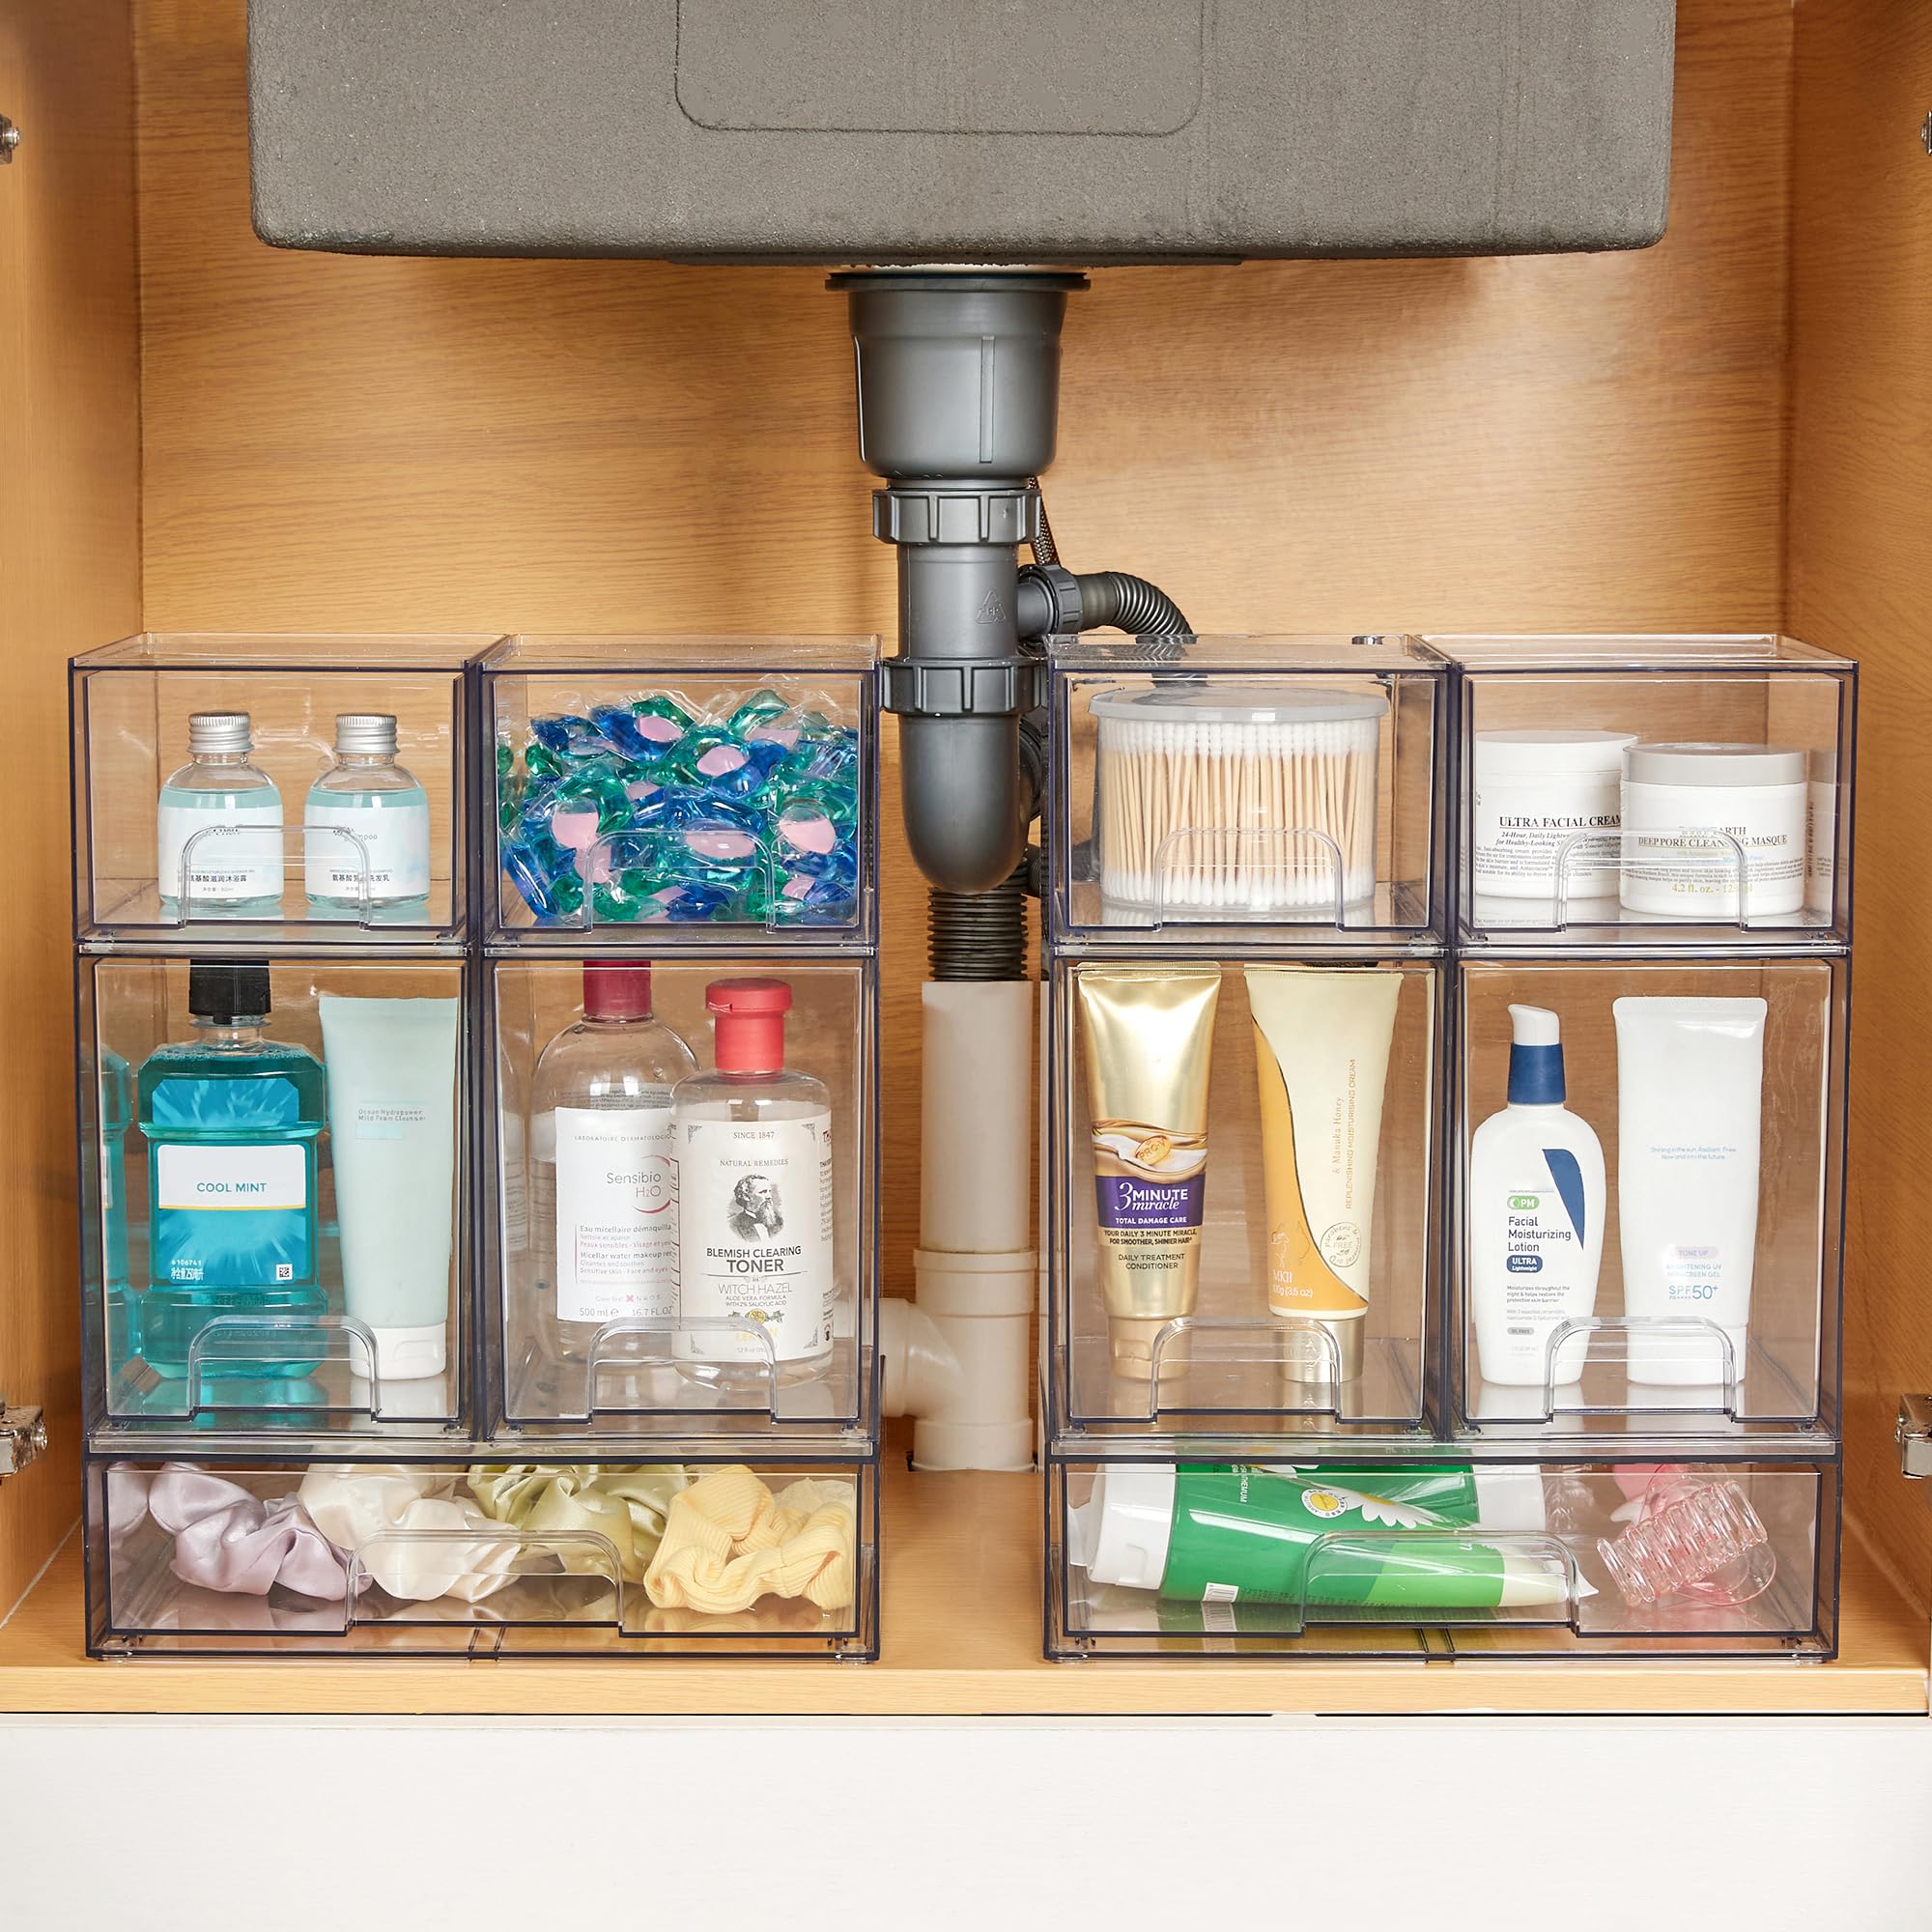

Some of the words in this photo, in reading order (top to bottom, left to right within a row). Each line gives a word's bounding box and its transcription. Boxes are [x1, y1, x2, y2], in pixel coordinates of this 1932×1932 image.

[1499, 816, 1539, 827] ULTRA
[1543, 817, 1586, 827] FACIAL
[1638, 837, 1659, 846] DEEP
[1661, 838, 1687, 847] PORE
[1751, 835, 1787, 846] MASQUE
[1672, 884, 1686, 893] 4.2
[1332, 1096, 1345, 1124] Honey
[1332, 1128, 1342, 1163] Manuka
[754, 1158, 789, 1167] REMEDIES
[607, 1172, 662, 1184] Sensibio
[196, 1182, 232, 1193] COOL
[236, 1182, 268, 1193] MINT
[1114, 1182, 1134, 1211] 3
[1133, 1189, 1188, 1201] MINUTE
[1132, 1197, 1179, 1211] miracle
[1520, 1199, 1535, 1208] PM
[1509, 1216, 1538, 1227] Facial
[633, 1224, 671, 1234] démaquilla
[1508, 1230, 1572, 1241] Moisturizing
[706, 1247, 751, 1259] BLEMISH
[753, 1245, 802, 1258] CLEARING
[1508, 1242, 1540, 1252] Lotion
[726, 1259, 784, 1273] TONER
[719, 1284, 755, 1295] WITCH
[758, 1283, 793, 1294] HAZEL
[580, 1308, 595, 1317] 500
[597, 1308, 608, 1317] ml
[633, 1308, 649, 1317] 16.7
